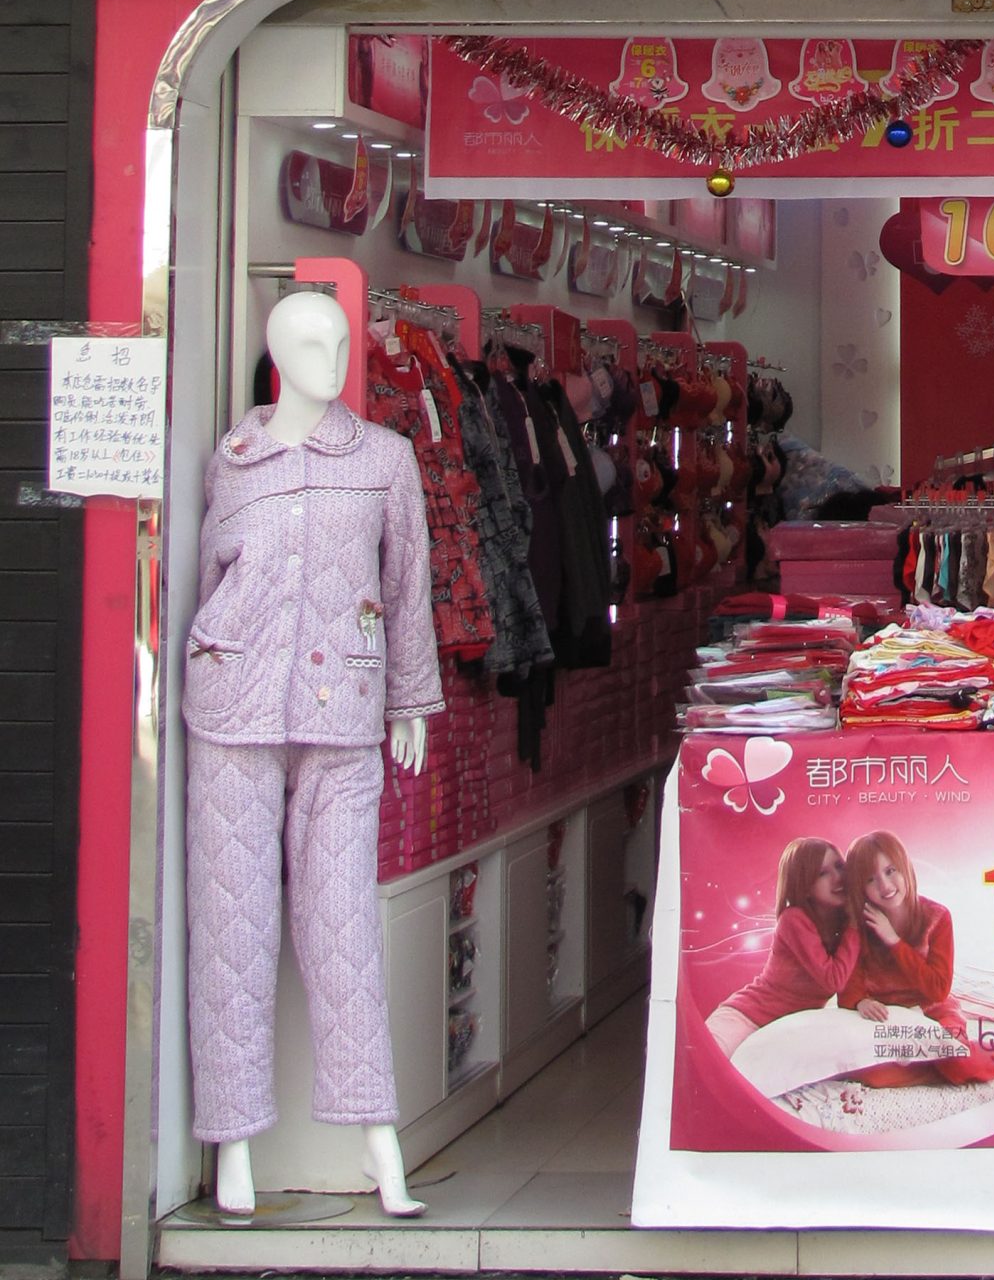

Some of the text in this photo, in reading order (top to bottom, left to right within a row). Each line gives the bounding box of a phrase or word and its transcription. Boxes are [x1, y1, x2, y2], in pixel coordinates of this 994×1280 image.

[806, 754, 969, 788] 都市丽人
[807, 790, 971, 806] CITY BEAUTY WIND
[873, 1024, 969, 1041] 品牌形象代言人
[873, 1044, 969, 1058] 亚洲超人气组合
